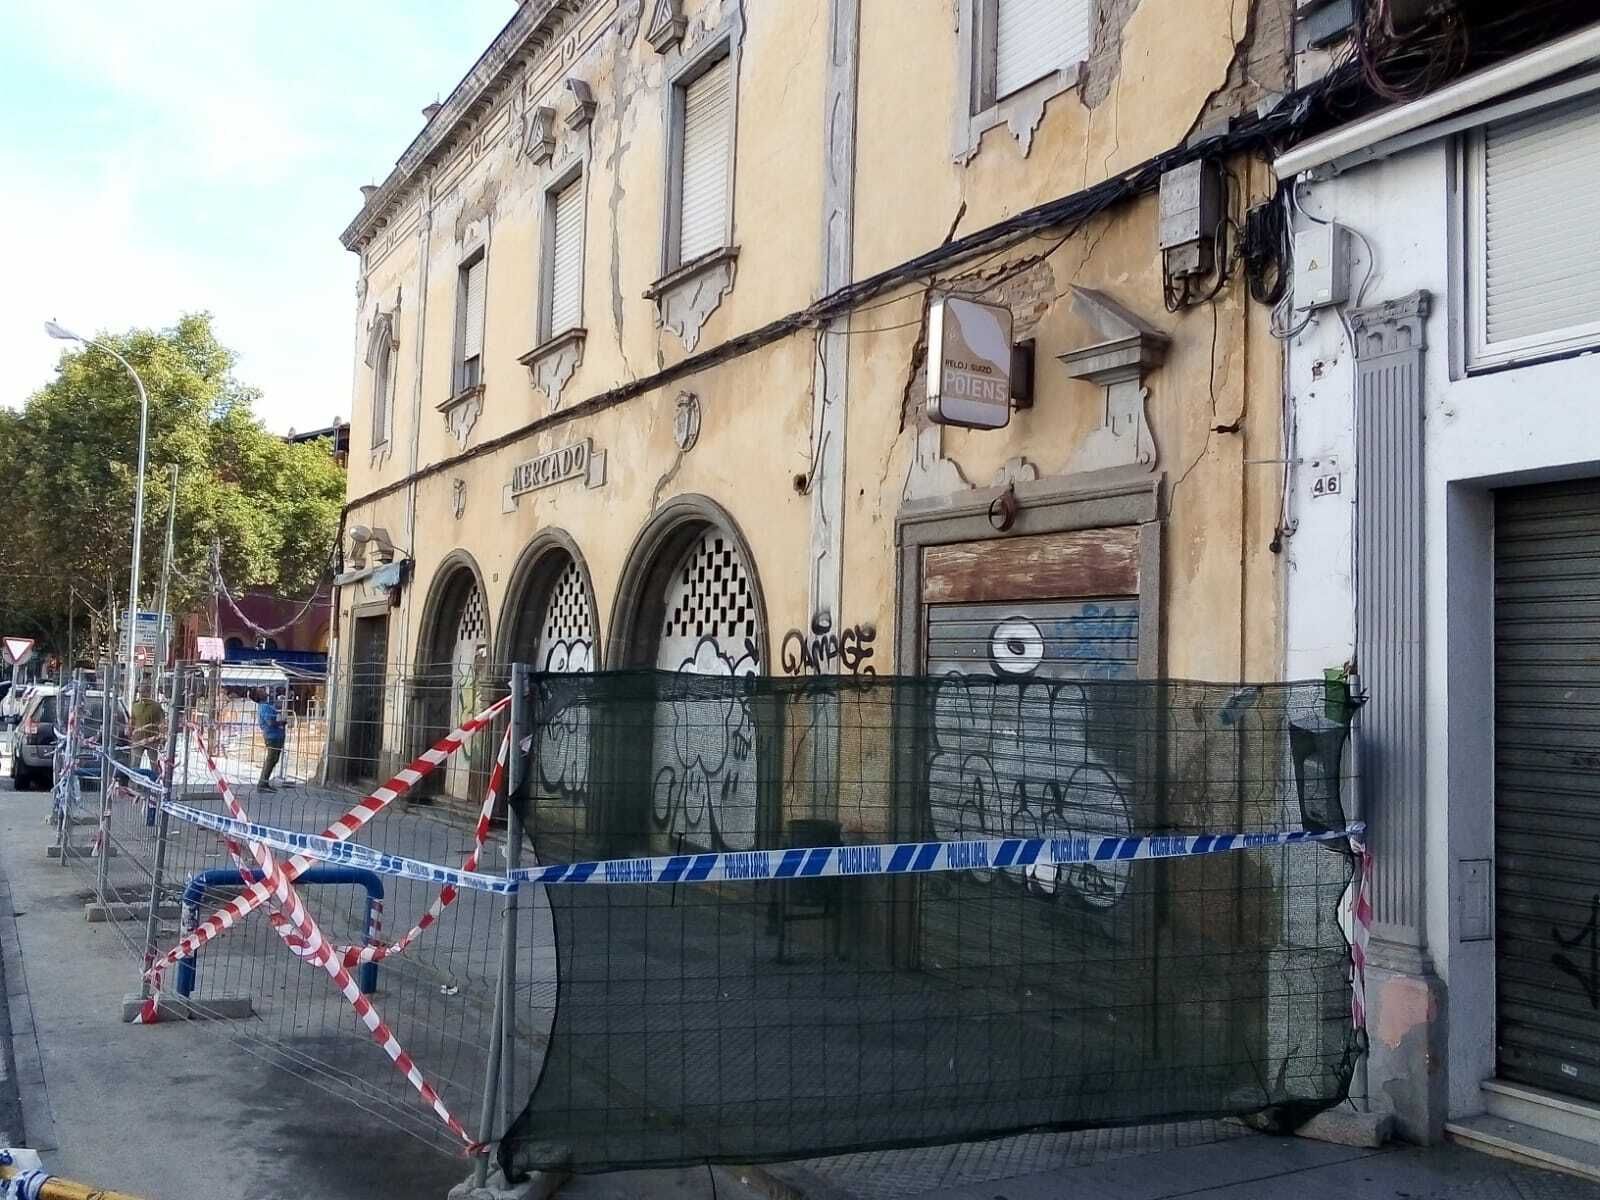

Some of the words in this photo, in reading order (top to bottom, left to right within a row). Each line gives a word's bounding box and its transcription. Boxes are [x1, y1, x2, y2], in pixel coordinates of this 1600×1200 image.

[512, 444, 585, 492] MERCADO
[1313, 476, 1337, 493] 46
[724, 852, 750, 879] POLICIA
[750, 851, 770, 878] LOCAL
[837, 847, 862, 875] POLICIA
[863, 846, 882, 873] LOCAL
[947, 842, 970, 868] POLICIA
[971, 840, 988, 867] LOCAL
[604, 860, 631, 882] POLICIA
[631, 858, 653, 882] LOCAL
